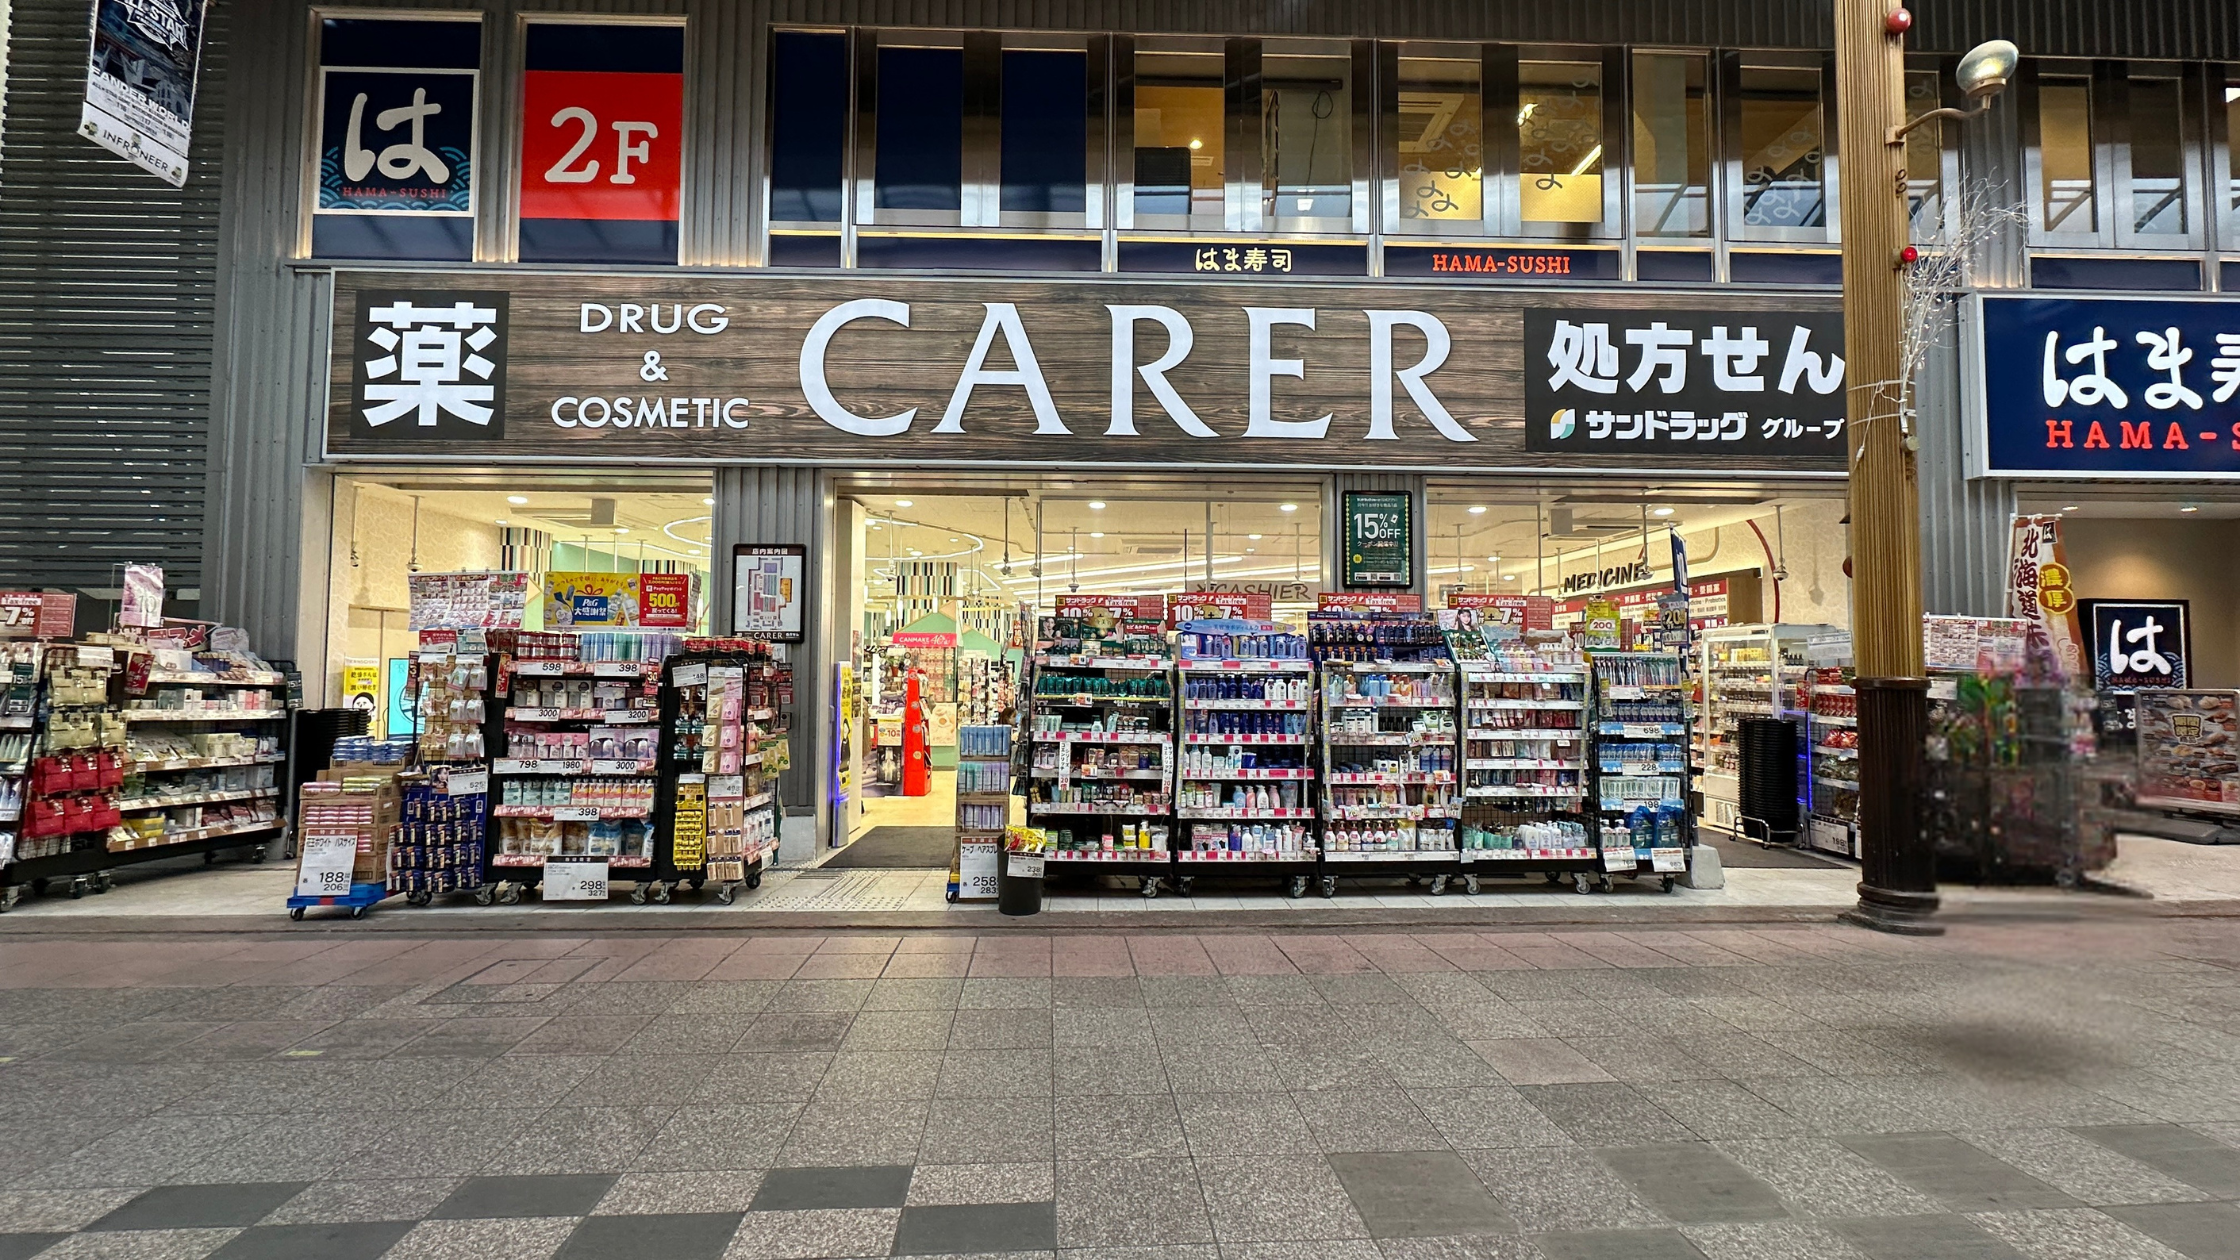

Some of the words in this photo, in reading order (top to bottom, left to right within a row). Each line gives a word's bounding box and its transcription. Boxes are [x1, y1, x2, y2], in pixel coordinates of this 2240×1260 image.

[148, 97, 191, 130] WORLD
[344, 87, 450, 184] は
[544, 106, 659, 184] 2F
[342, 187, 447, 199] HAMA-SUSHI
[1194, 247, 1293, 273] はま寿司
[1431, 253, 1571, 275] HAMA-SUSHI
[579, 302, 730, 335] DRUG
[1547, 319, 1846, 396] 処方せん
[361, 301, 498, 428] 薬
[639, 350, 669, 382] &
[799, 297, 1479, 443] CARER
[550, 395, 751, 429] COSMETIC
[1585, 410, 1749, 441] サンドラッグ
[1760, 417, 1846, 440] グループ
[1379, 528, 1401, 539] OFF
[1563, 561, 1646, 593] MEDICINE
[1212, 582, 1312, 600] CASHIER
[582, 598, 599, 607] P&G
[574, 607, 607, 617] 大感謝祭
[1593, 621, 1613, 629] 200
[753, 632, 783, 640] CARER
[2109, 615, 2173, 675] は
[542, 662, 561, 671] 598
[618, 664, 638, 672] 398
[538, 709, 558, 717] 3000
[628, 710, 647, 719] 3200
[1643, 726, 1660, 734] 698
[519, 761, 538, 769] 798
[562, 761, 581, 769] 1980
[615, 761, 635, 770] 3000
[1641, 763, 1658, 771] 228
[1644, 800, 1660, 809] 198
[578, 807, 598, 816] 398
[962, 845, 974, 854] ケープ
[319, 871, 344, 883] 188
[973, 876, 997, 886] 258
[323, 883, 343, 891] 206
[580, 880, 602, 890] 298
[980, 886, 997, 894] 283
